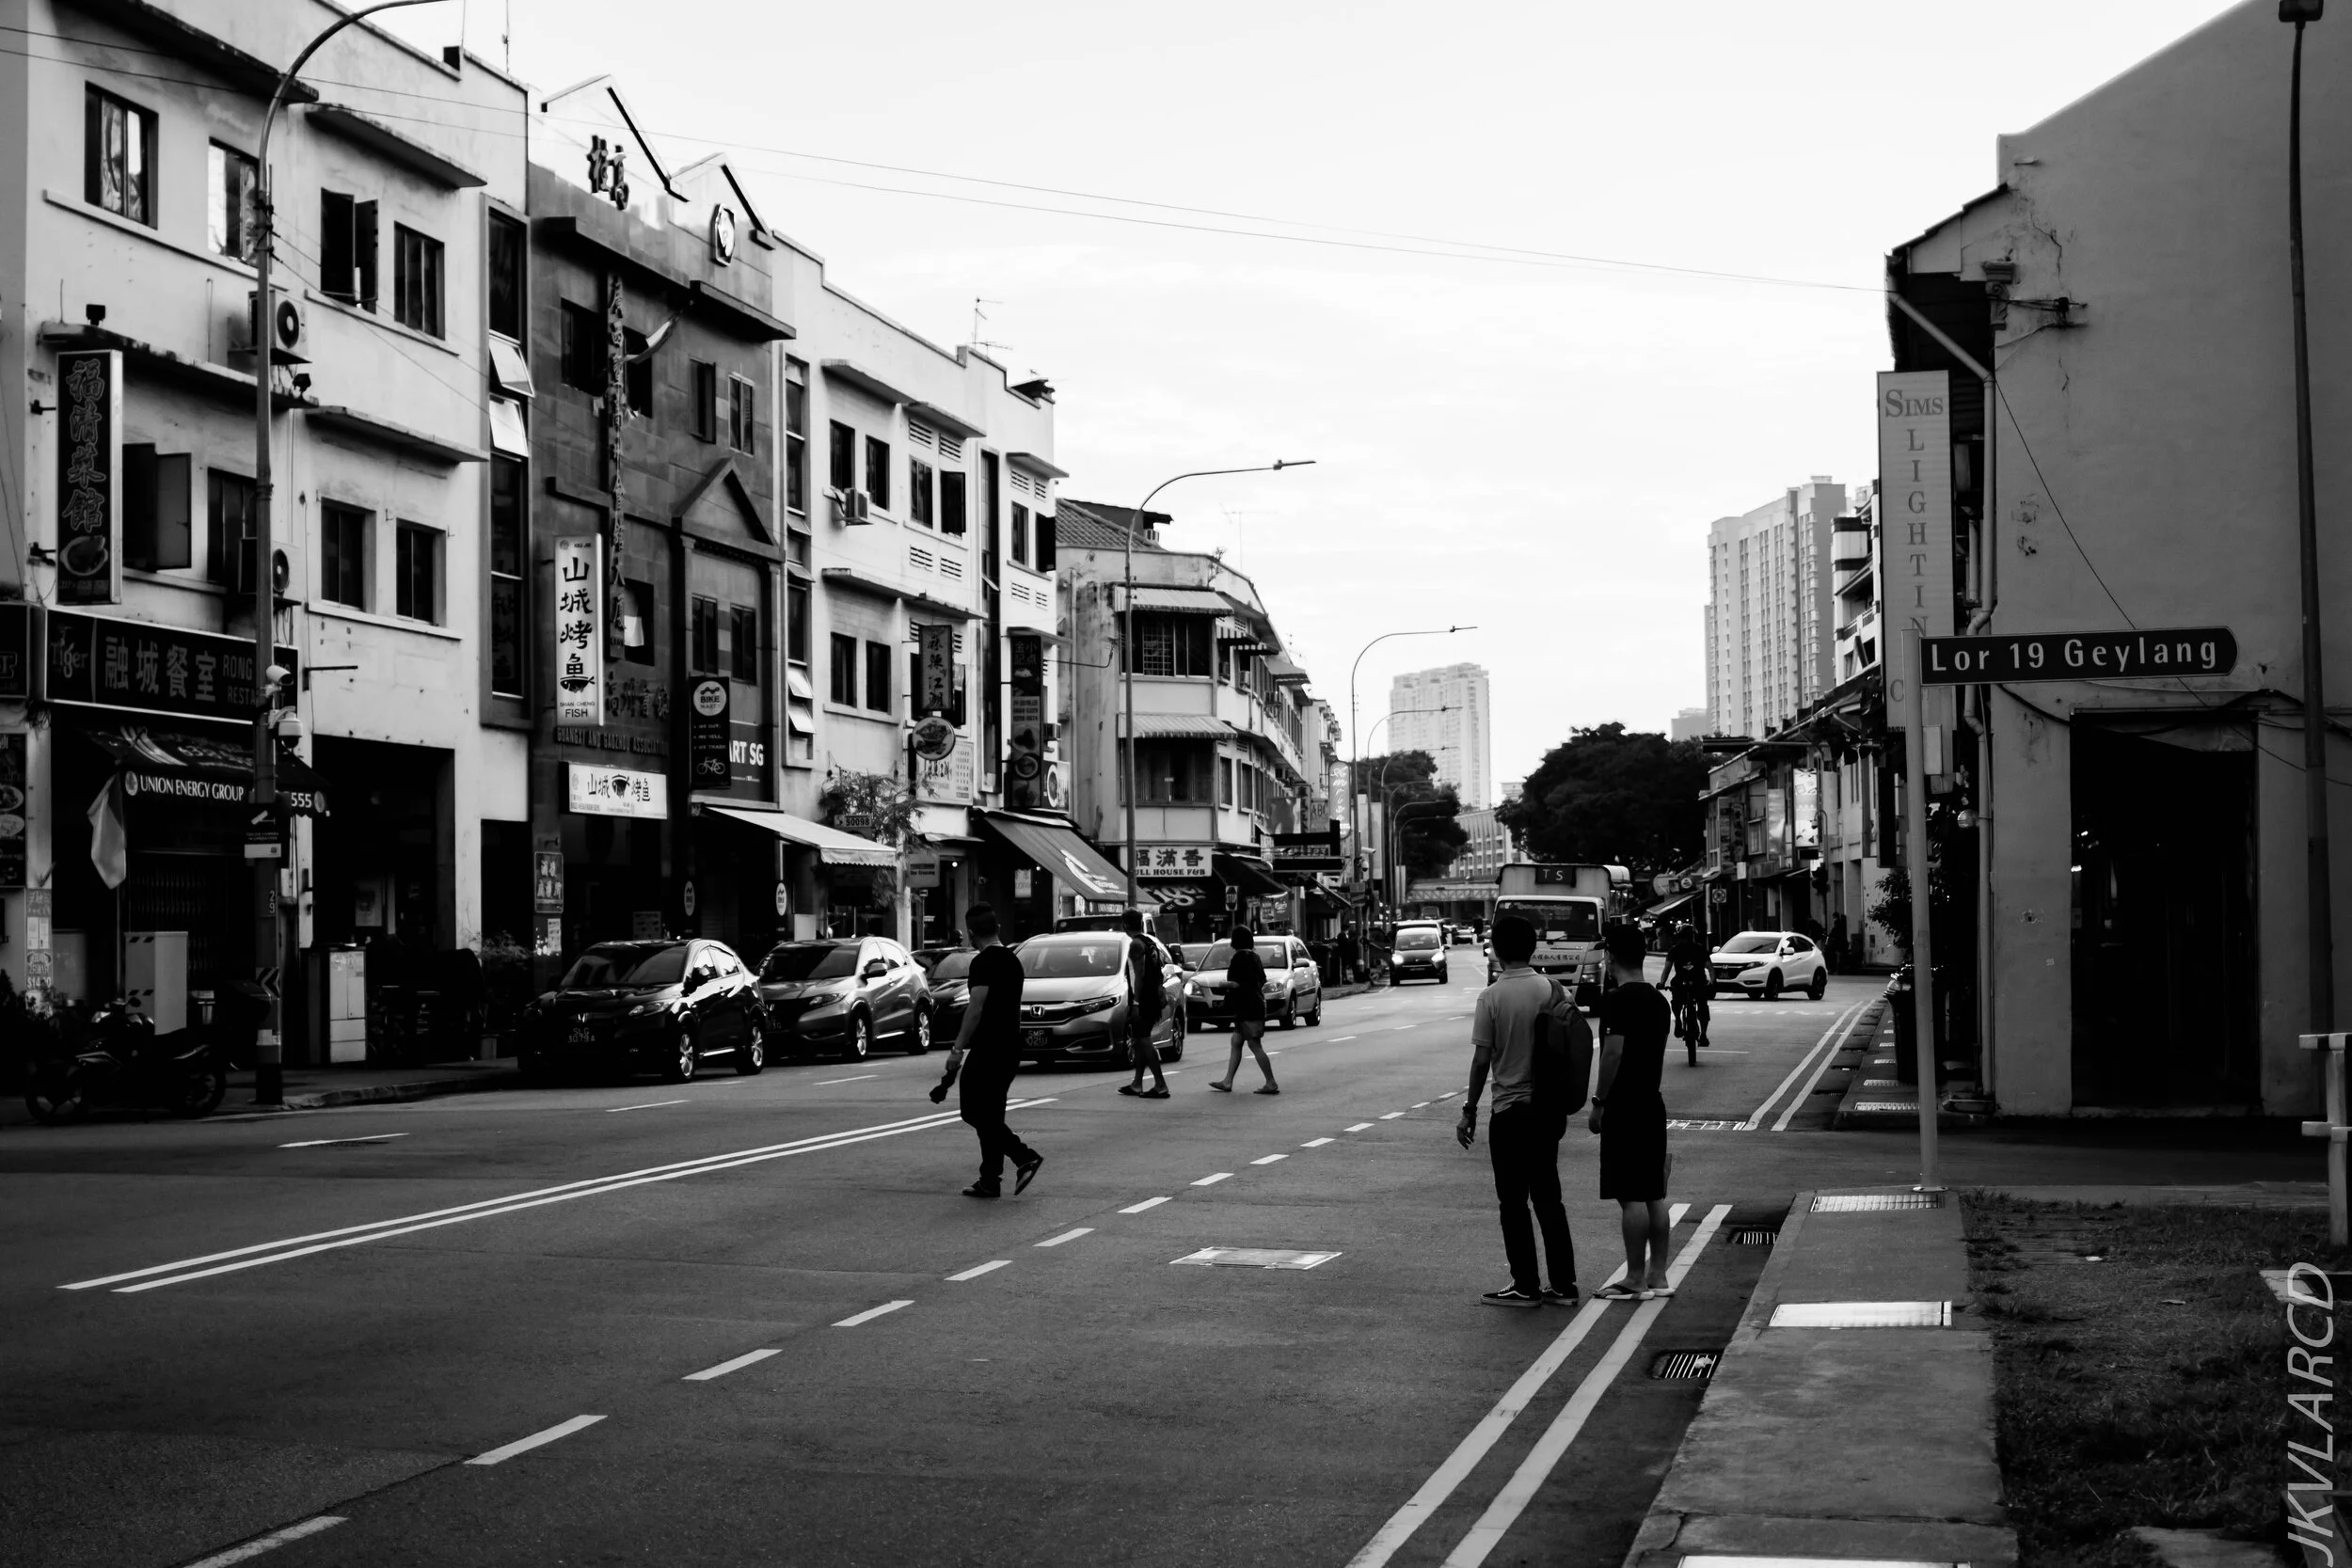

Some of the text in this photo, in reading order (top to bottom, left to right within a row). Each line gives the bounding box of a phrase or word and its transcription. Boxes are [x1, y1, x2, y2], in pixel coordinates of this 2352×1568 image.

[62, 358, 106, 532] 福清菜館
[50, 632, 89, 679] Tiger
[1931, 636, 2217, 672] Lor 19 Geylang
[104, 635, 216, 703] 融城餐室
[222, 654, 253, 681] RONG
[700, 695, 720, 704] BIKE
[564, 708, 588, 718] FISH
[588, 730, 600, 748] AND
[749, 742, 764, 767] SG
[140, 776, 245, 801] UNION ENERGY GROUP
[291, 792, 312, 808] 555
